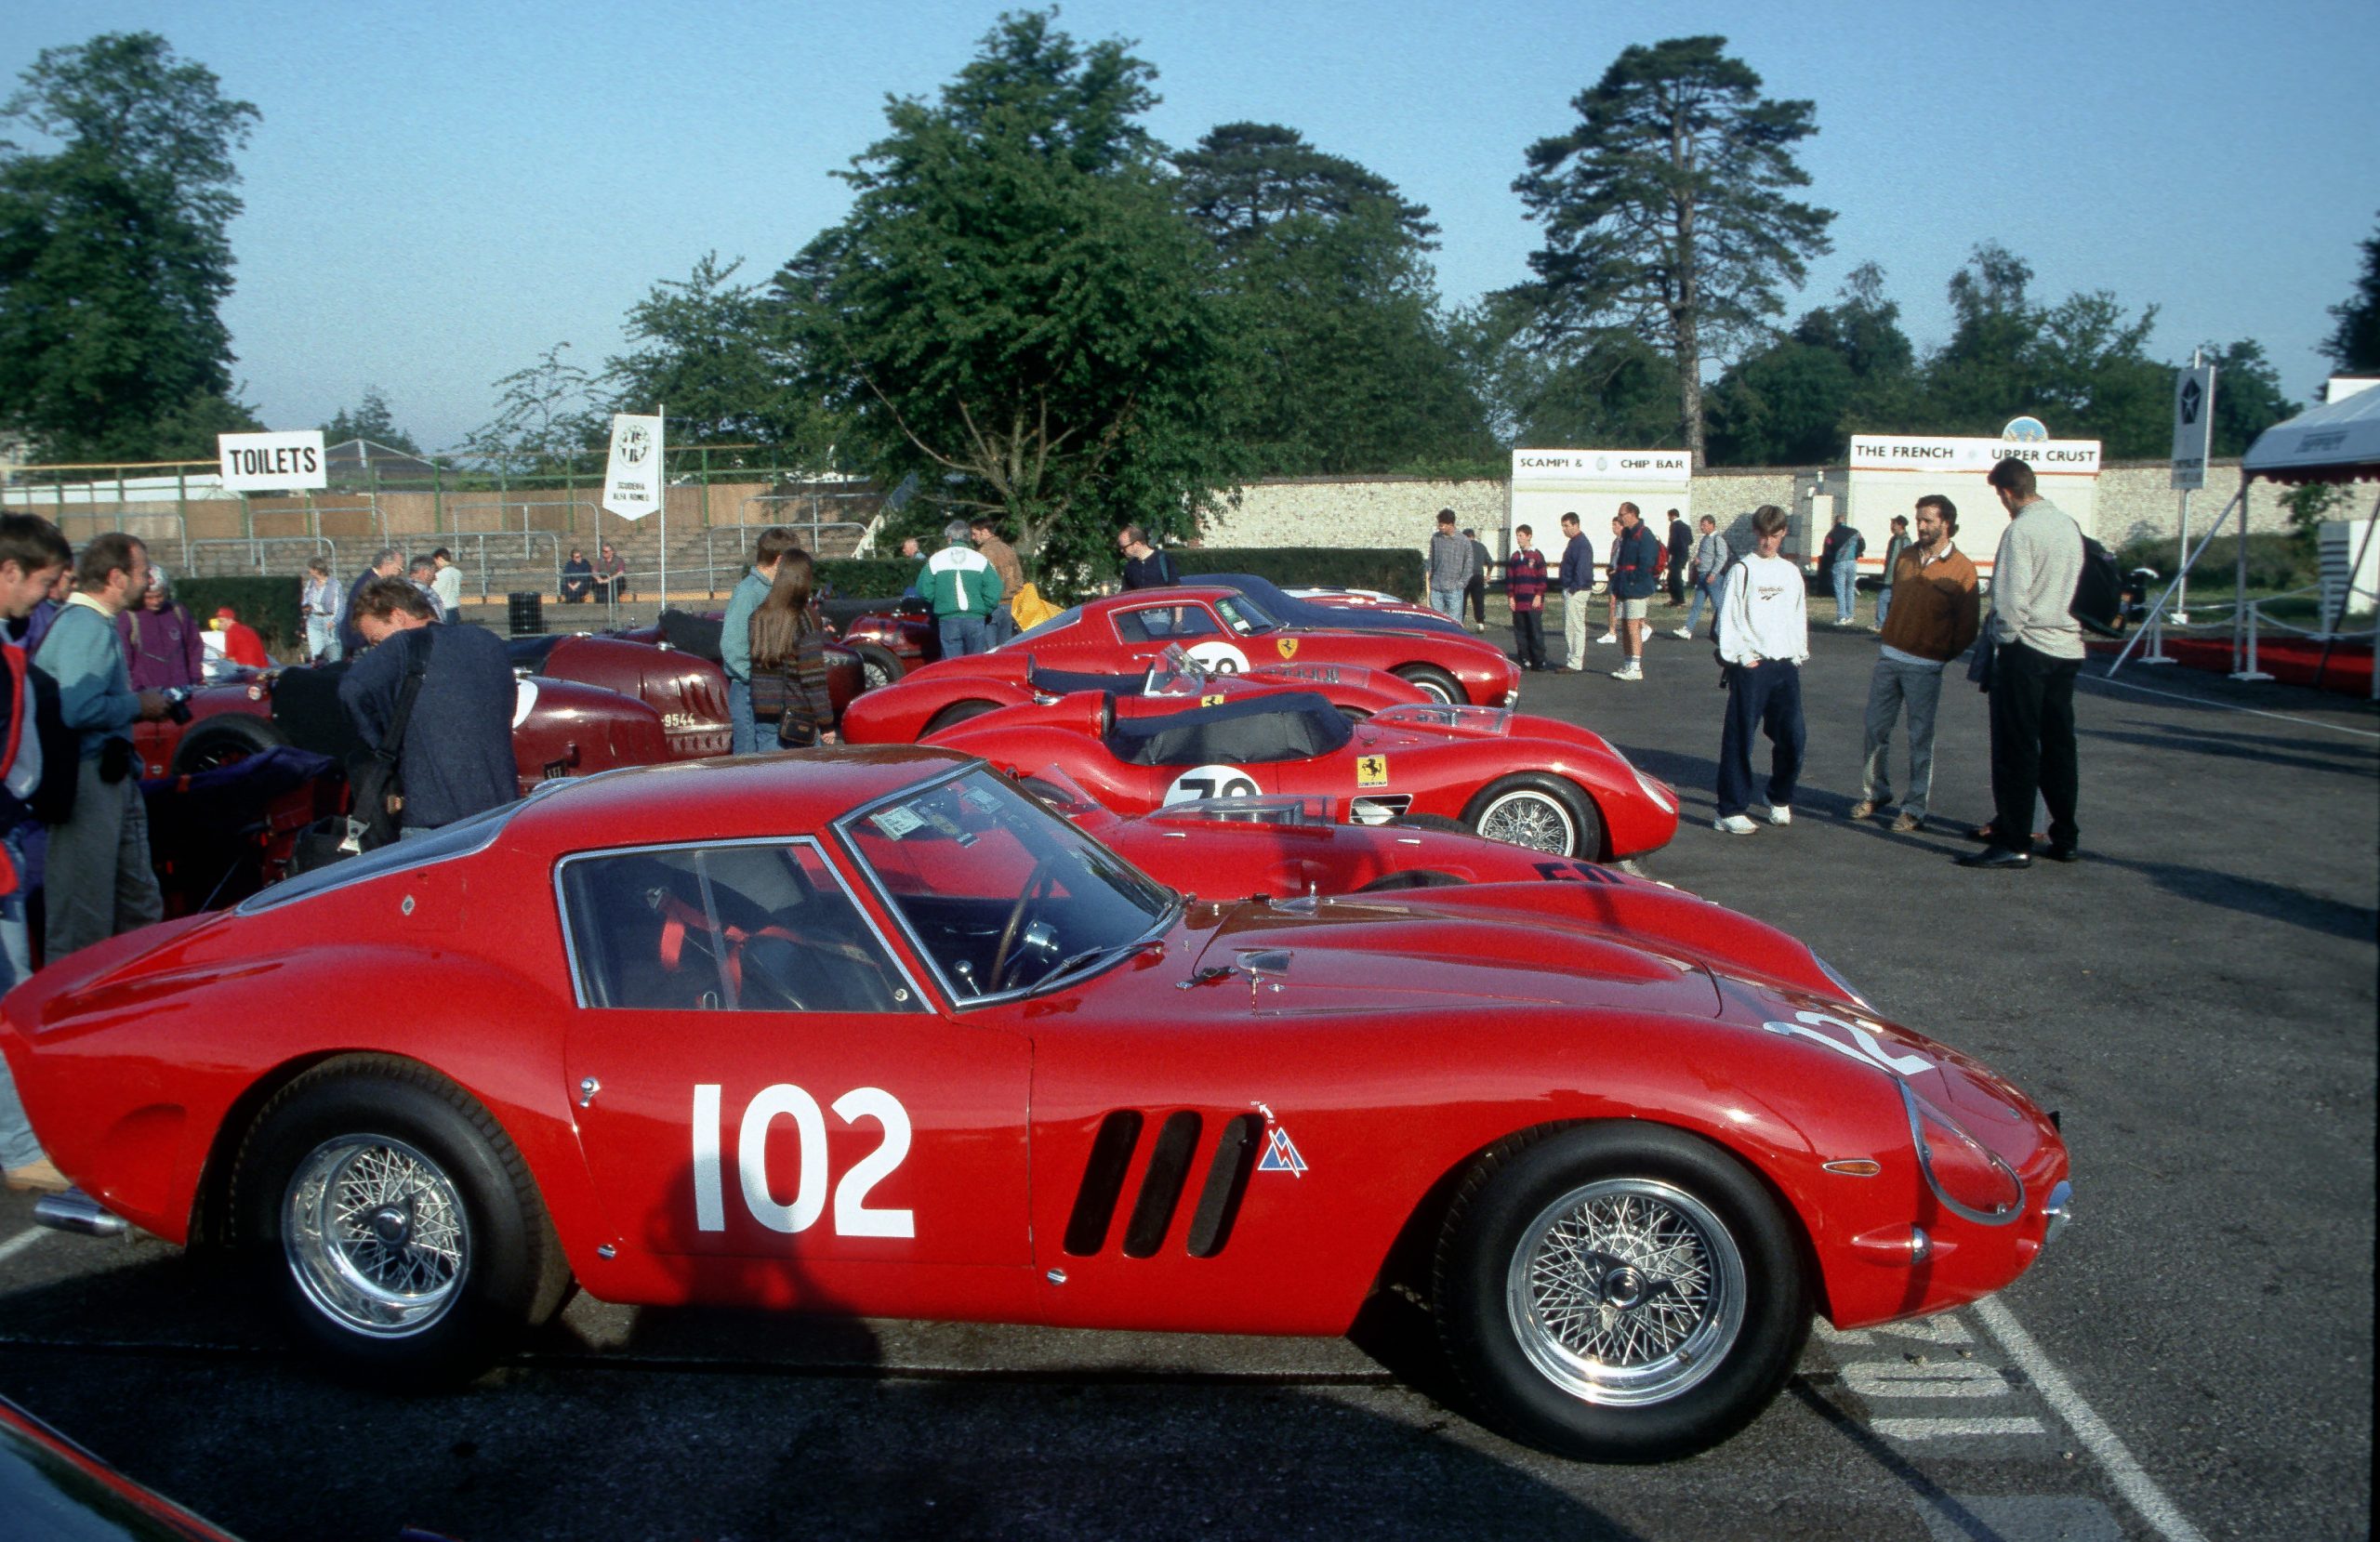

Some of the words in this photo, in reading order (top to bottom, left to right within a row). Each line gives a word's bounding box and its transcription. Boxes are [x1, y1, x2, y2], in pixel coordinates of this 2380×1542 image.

[229, 446, 317, 475] TOILETS
[1520, 458, 1569, 468] SCAMPI
[1575, 458, 1582, 467] &
[1620, 459, 1650, 468] CHIP
[1657, 459, 1684, 468] BAR
[1856, 445, 1885, 457] THE
[1892, 446, 1953, 458] FRENCH
[1991, 448, 2040, 461] UPPER
[2046, 450, 2096, 462] CRUST
[693, 1083, 916, 1238] 102
